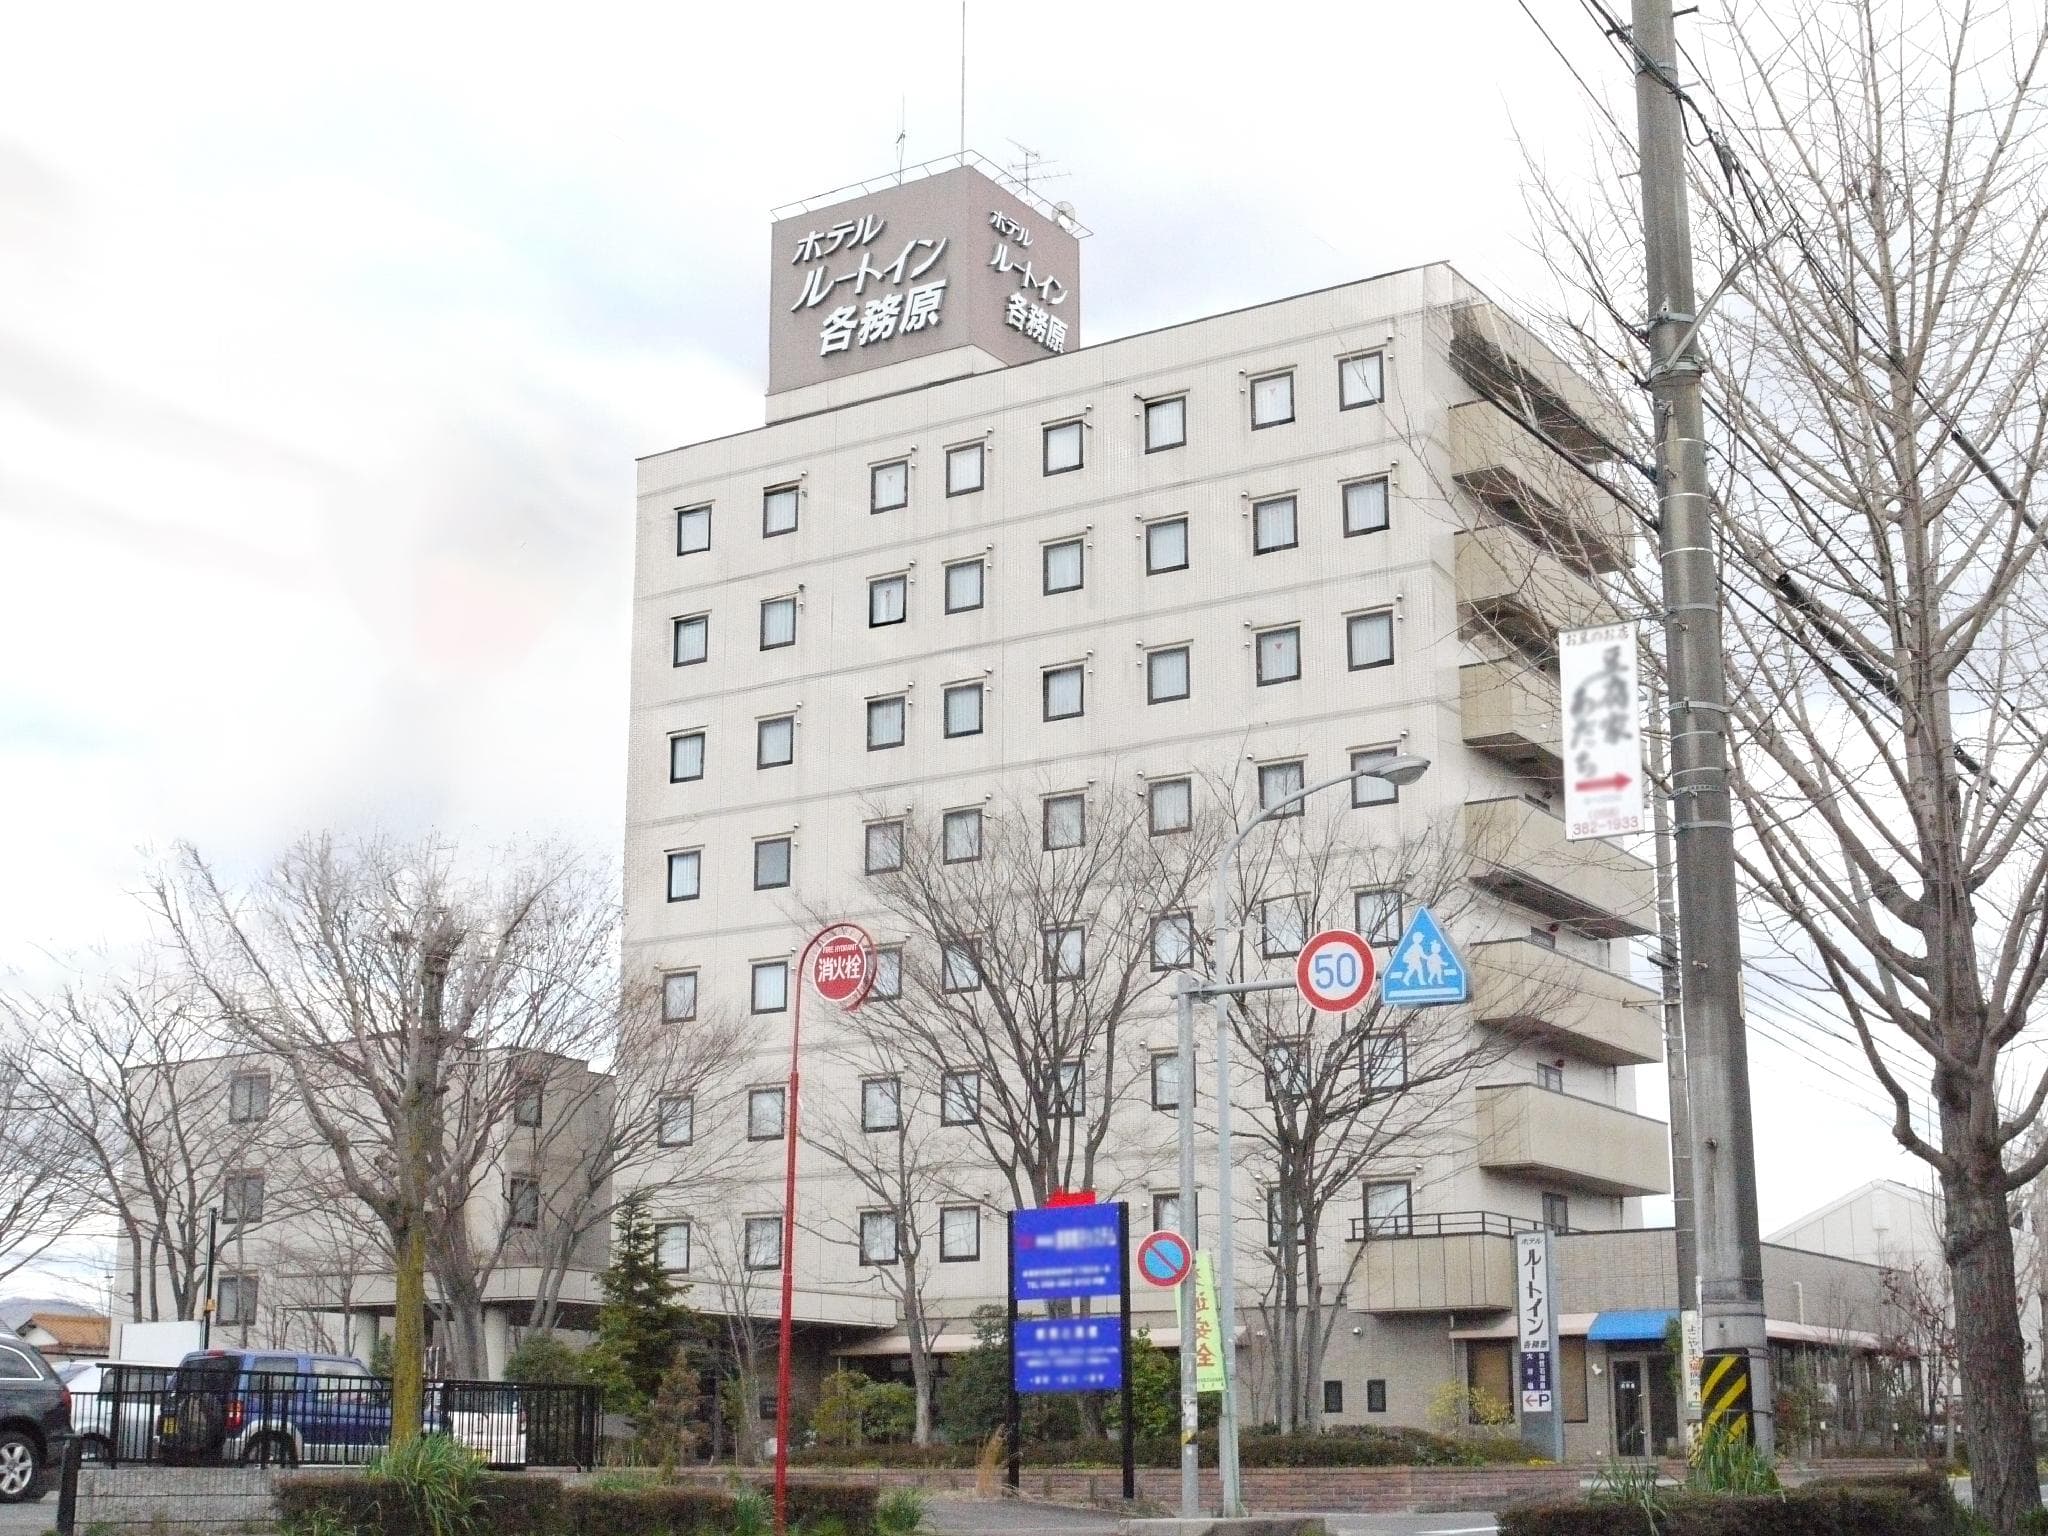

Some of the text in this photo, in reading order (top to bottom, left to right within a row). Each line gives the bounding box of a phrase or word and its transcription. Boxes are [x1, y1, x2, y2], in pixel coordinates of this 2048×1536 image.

[792, 214, 885, 265] ホテル
[989, 210, 1034, 247] ホテル
[791, 237, 948, 312] ルートイン
[990, 242, 1069, 305] ルートイン
[820, 278, 948, 356] 各務原
[1006, 292, 1069, 353] 各務原
[1573, 816, 1639, 836] 382-1933
[818, 954, 861, 982] 消火栓
[1314, 952, 1356, 989] 50
[1524, 1248, 1544, 1336] ルートイン
[1538, 1394, 1550, 1407] P
